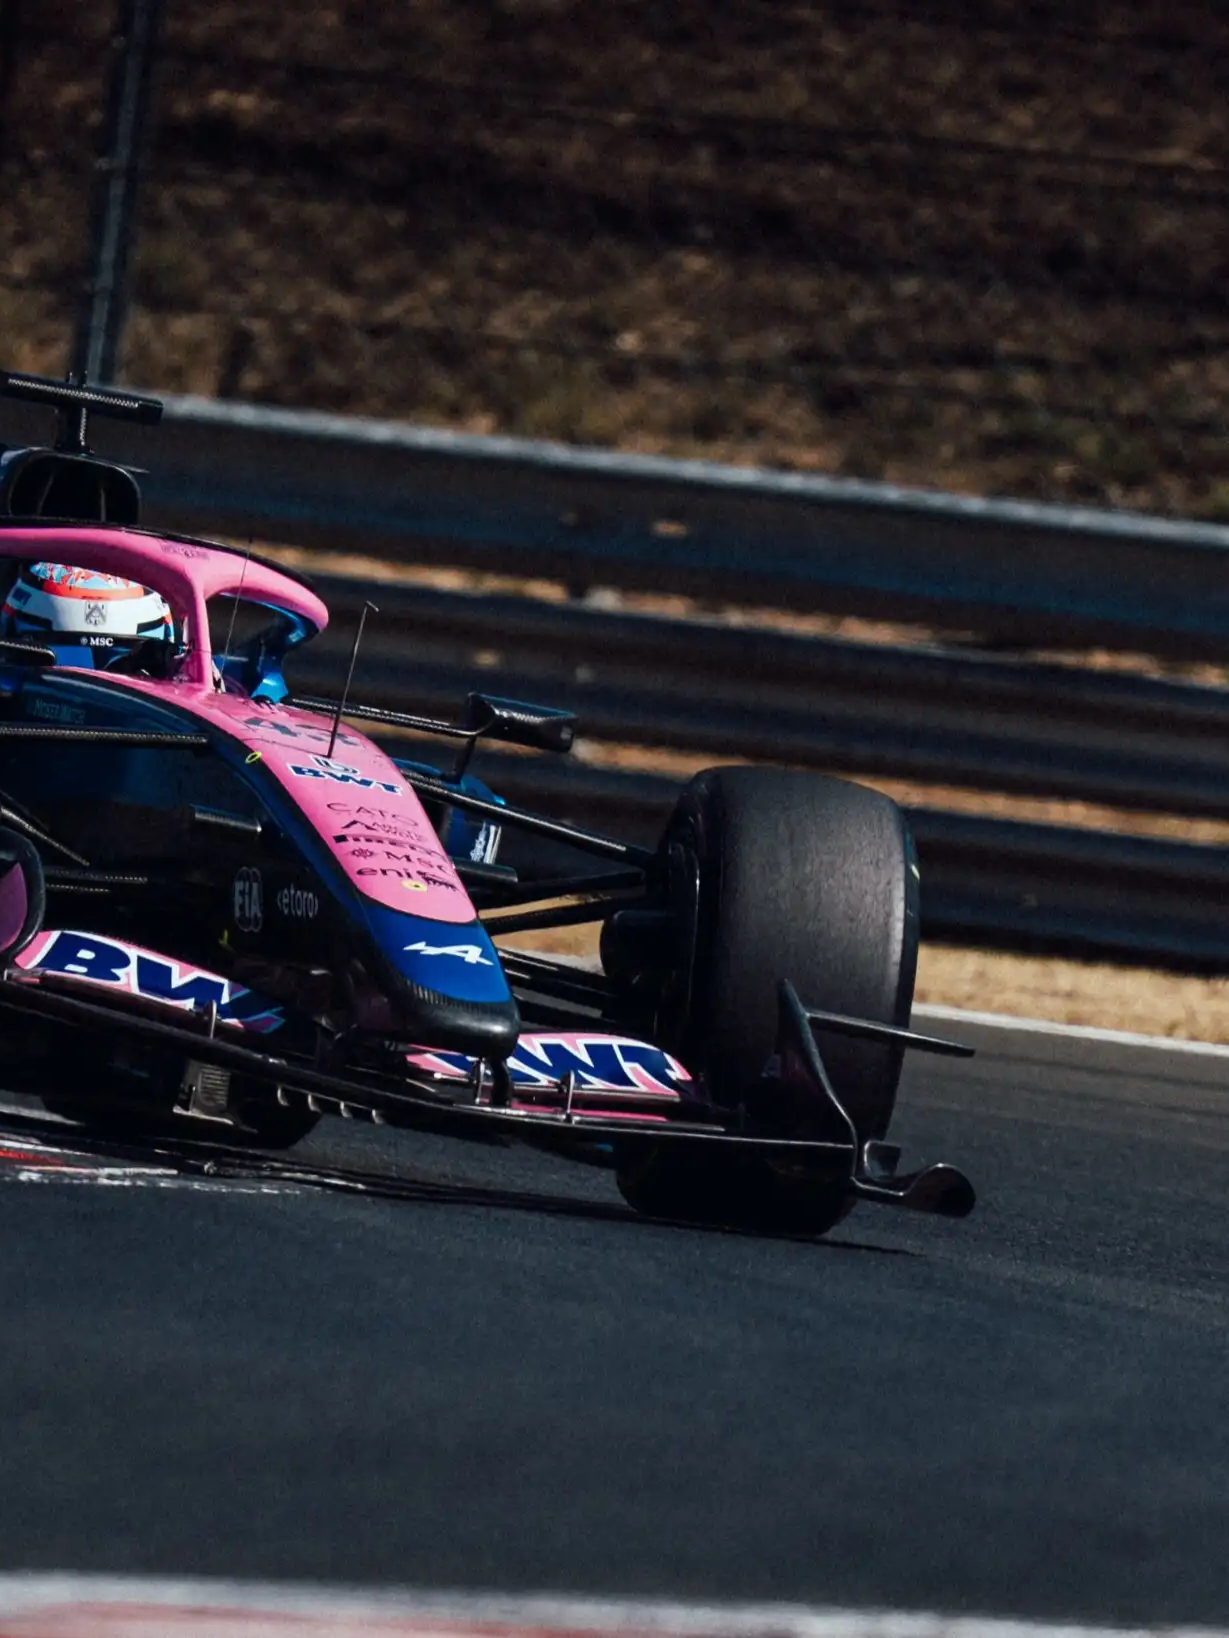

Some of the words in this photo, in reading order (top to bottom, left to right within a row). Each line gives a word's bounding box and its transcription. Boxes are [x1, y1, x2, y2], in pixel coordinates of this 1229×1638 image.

[89, 636, 114, 647] MSC
[290, 765, 402, 794] BWT
[356, 866, 413, 880] eni
[234, 880, 263, 919] FIA
